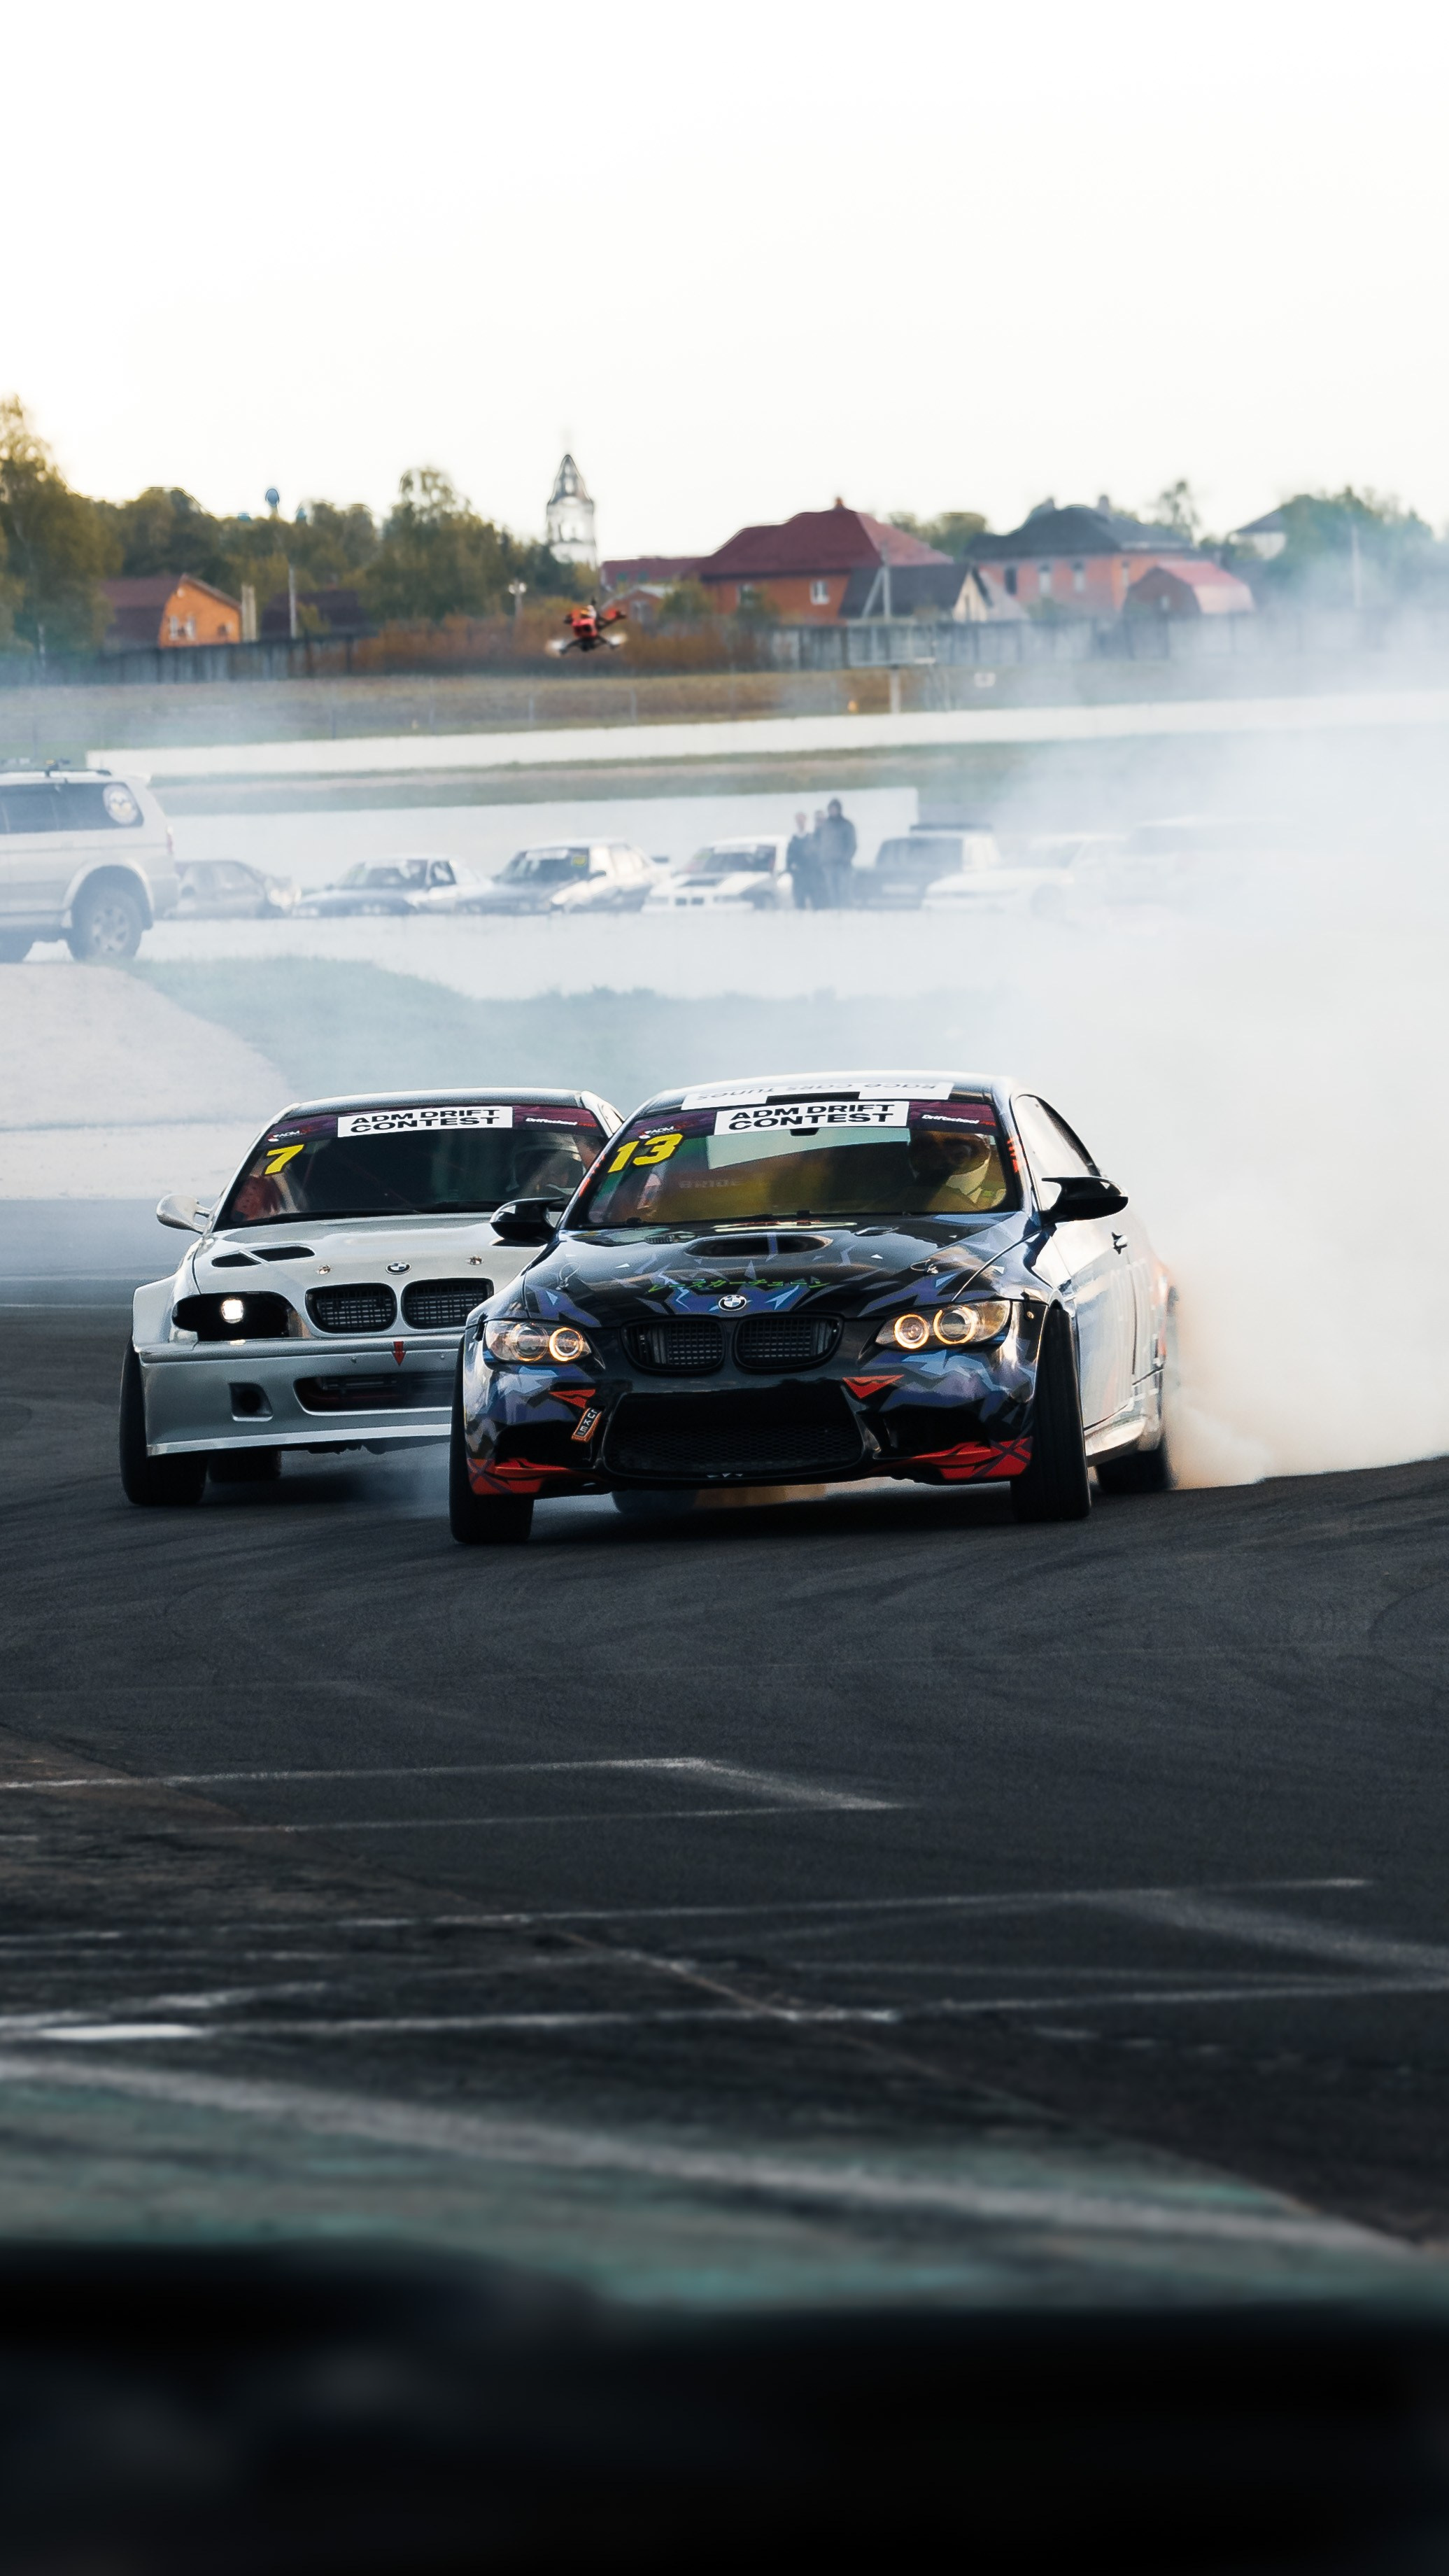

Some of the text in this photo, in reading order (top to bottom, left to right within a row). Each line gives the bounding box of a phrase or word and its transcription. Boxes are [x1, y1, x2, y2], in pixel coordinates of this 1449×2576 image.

[351, 1109, 500, 1125] ADM DRIFT
[730, 1104, 896, 1121] ADM DRIFT
[351, 1116, 500, 1133] CONTEST
[728, 1113, 894, 1131] CONTEST
[264, 1143, 305, 1175] 7
[607, 1132, 684, 1174] 13
